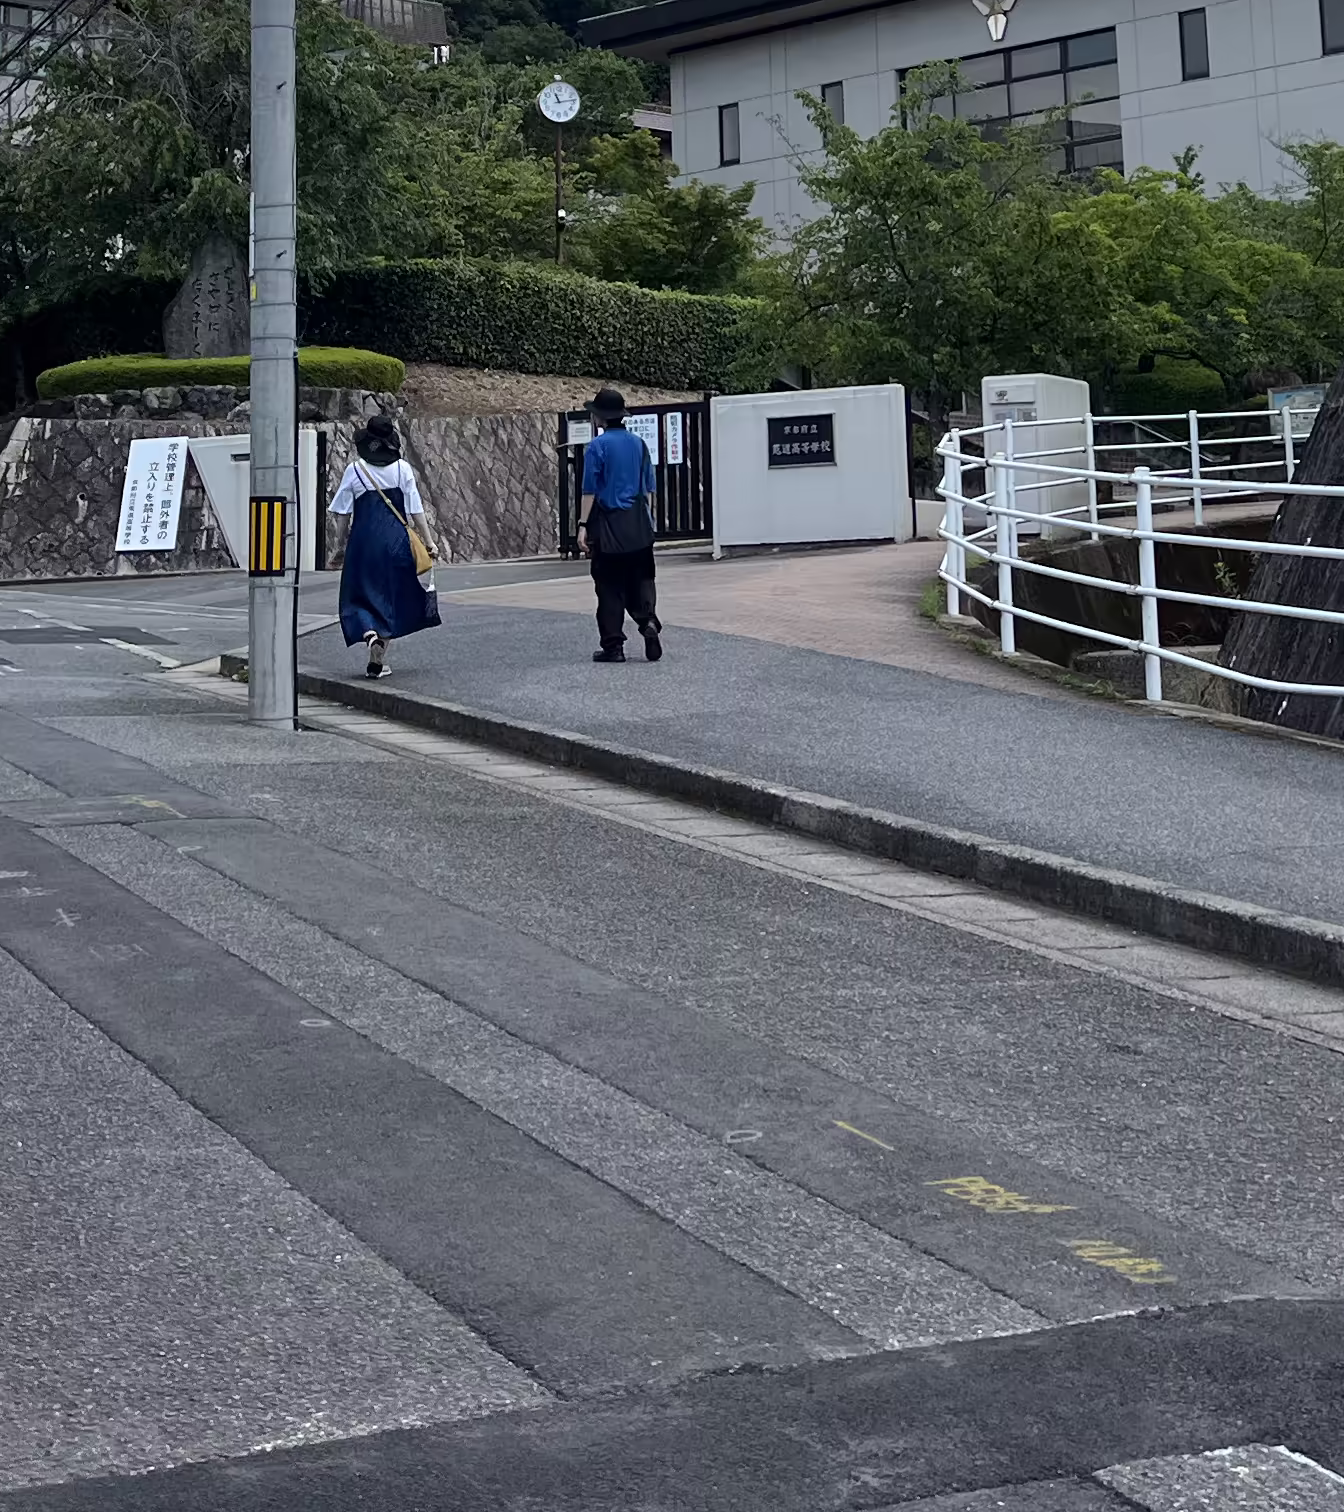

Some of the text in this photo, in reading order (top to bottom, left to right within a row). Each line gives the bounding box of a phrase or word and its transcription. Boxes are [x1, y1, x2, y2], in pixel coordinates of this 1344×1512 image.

[139, 461, 160, 545] 立入りを禁止する
